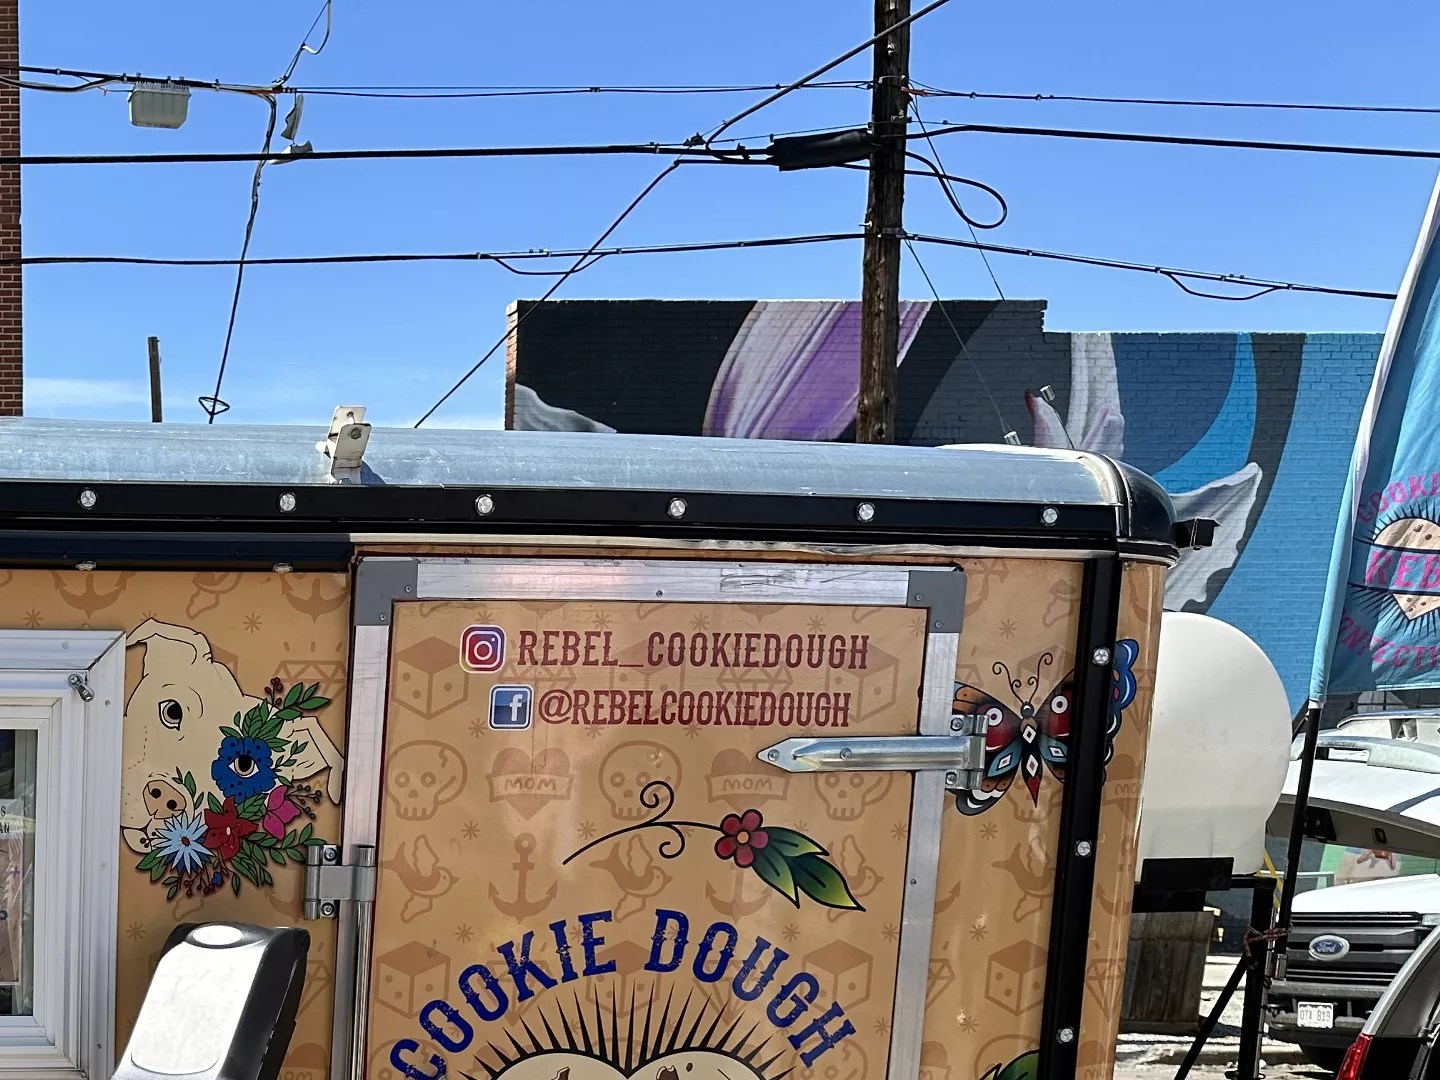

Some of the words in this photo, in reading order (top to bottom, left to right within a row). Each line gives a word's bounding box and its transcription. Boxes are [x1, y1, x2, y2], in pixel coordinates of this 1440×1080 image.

[518, 629, 869, 671] REBEL_COOKIEDOUGH
[538, 690, 850, 728] @REBELCOOKIEDOUGH
[504, 774, 558, 791] MOM
[1317, 942, 1336, 952] Ford
[644, 908, 856, 1069] DOUGH
